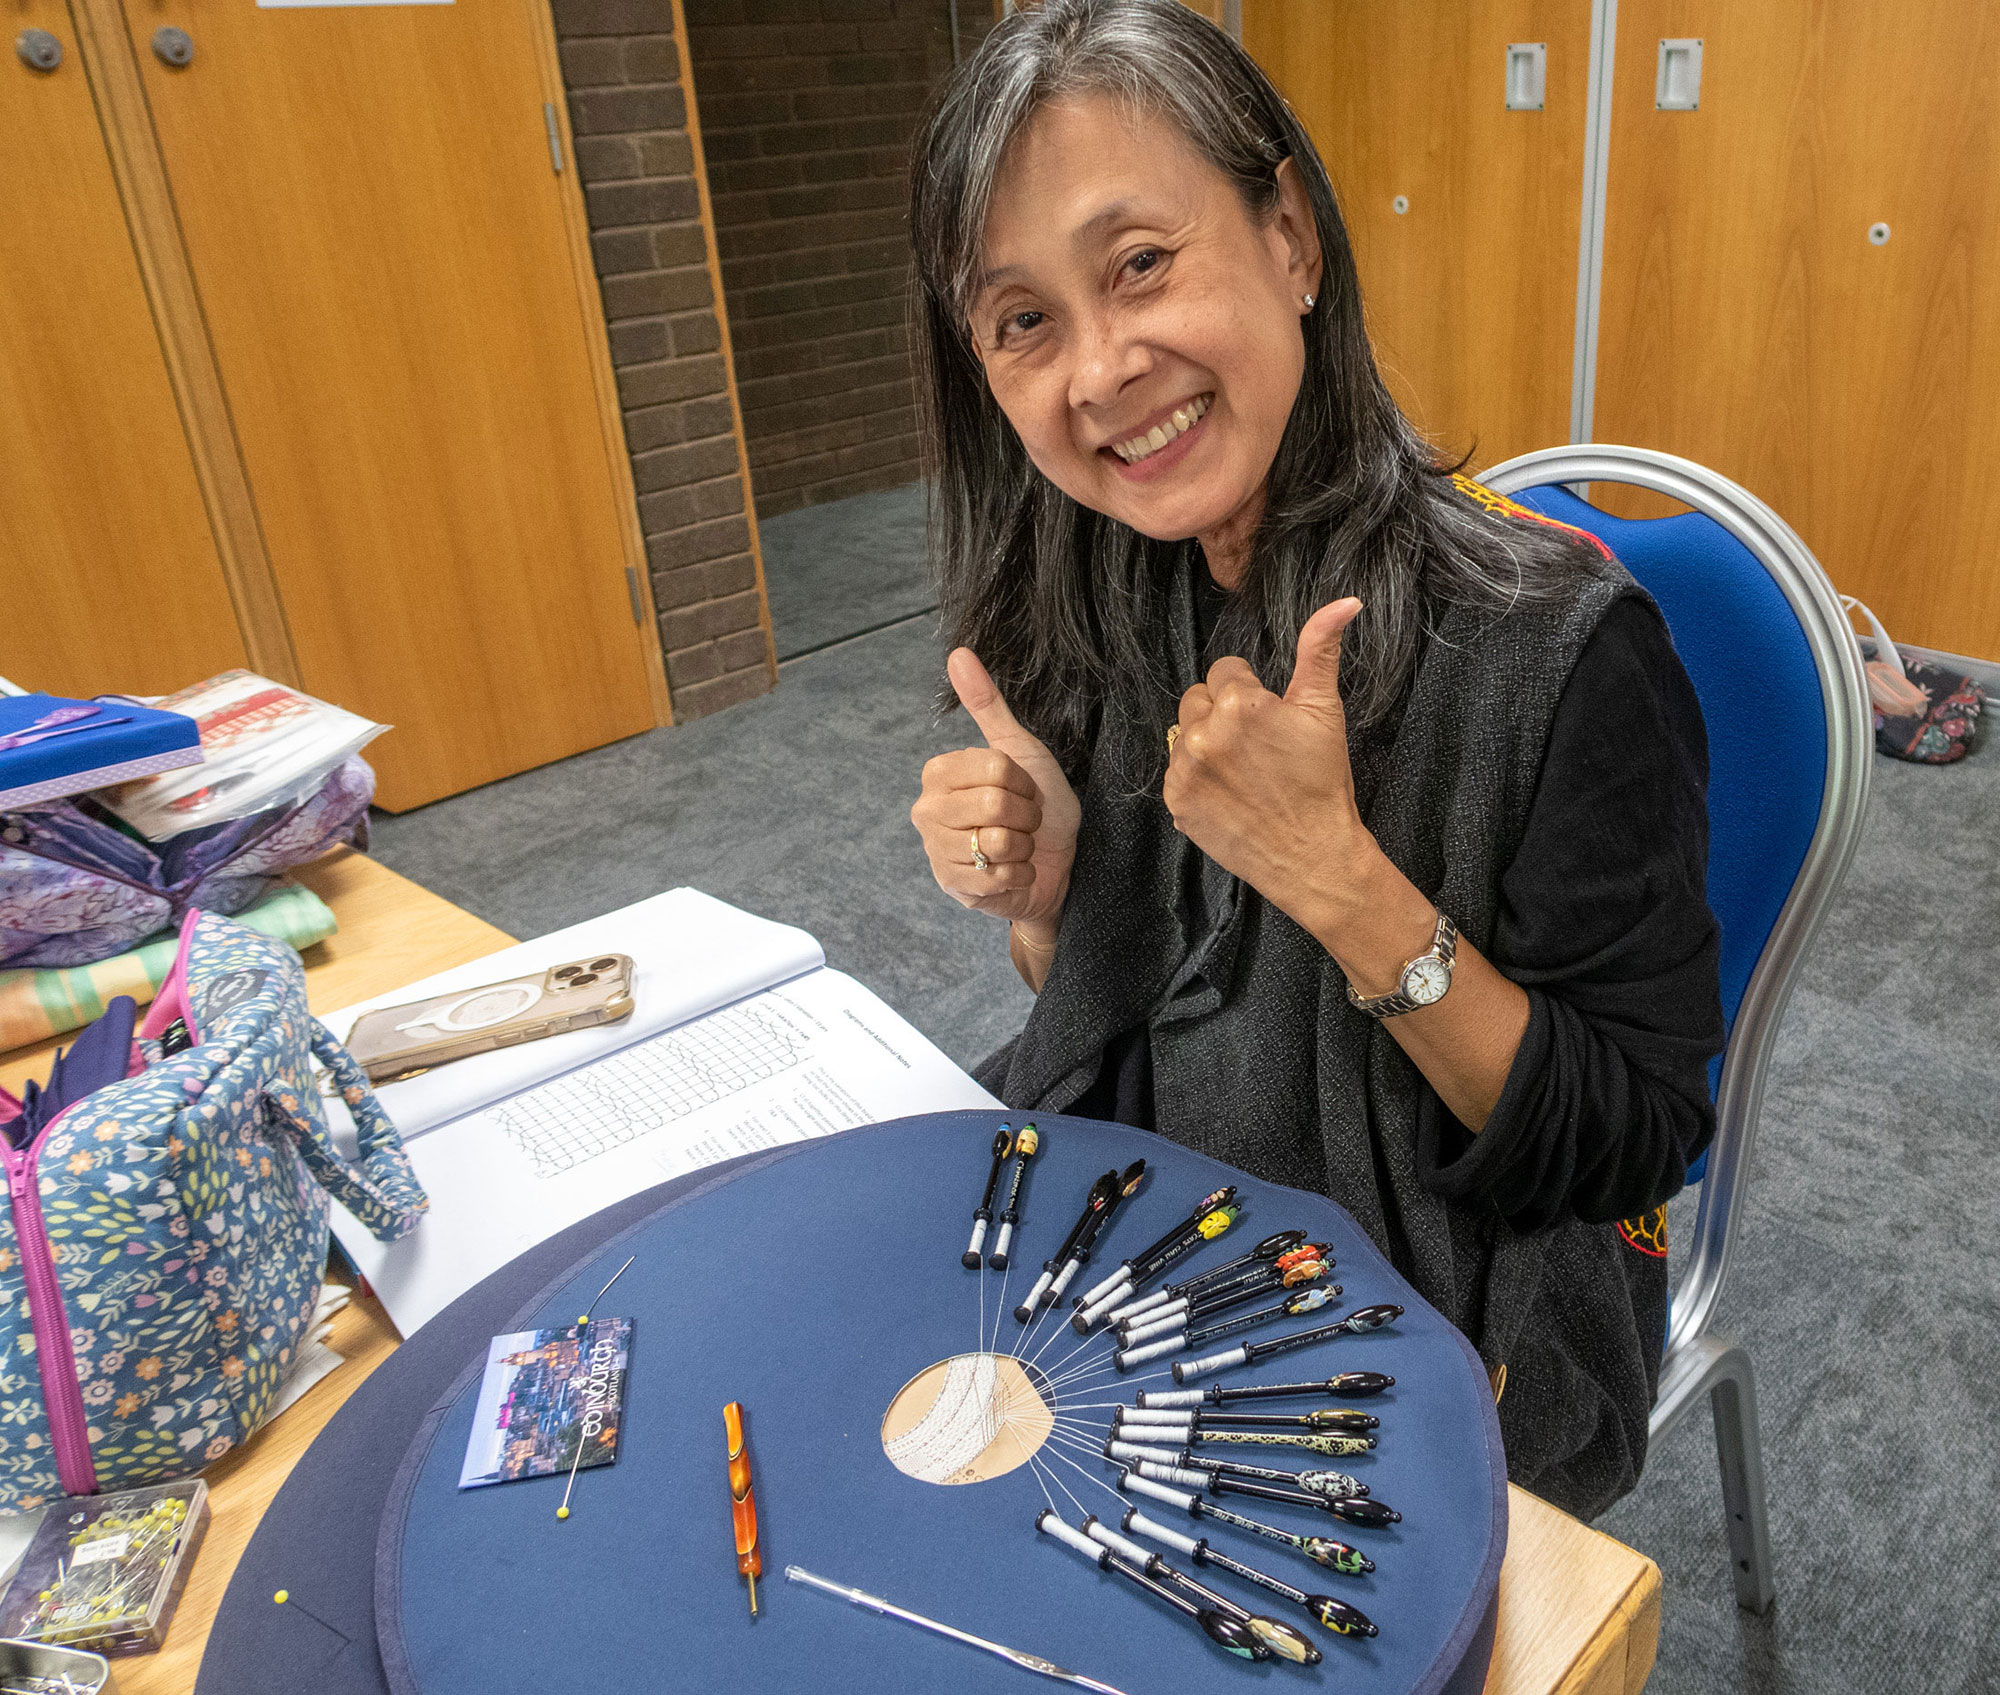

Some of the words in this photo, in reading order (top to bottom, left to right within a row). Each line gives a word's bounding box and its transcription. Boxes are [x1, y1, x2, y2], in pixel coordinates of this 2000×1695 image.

[843, 1009, 865, 1028] Diagrams
[864, 1026, 875, 1035] and
[873, 1034, 898, 1056] Additional
[896, 1054, 912, 1069] Notes
[581, 1338, 617, 1437] EDINBURGH
